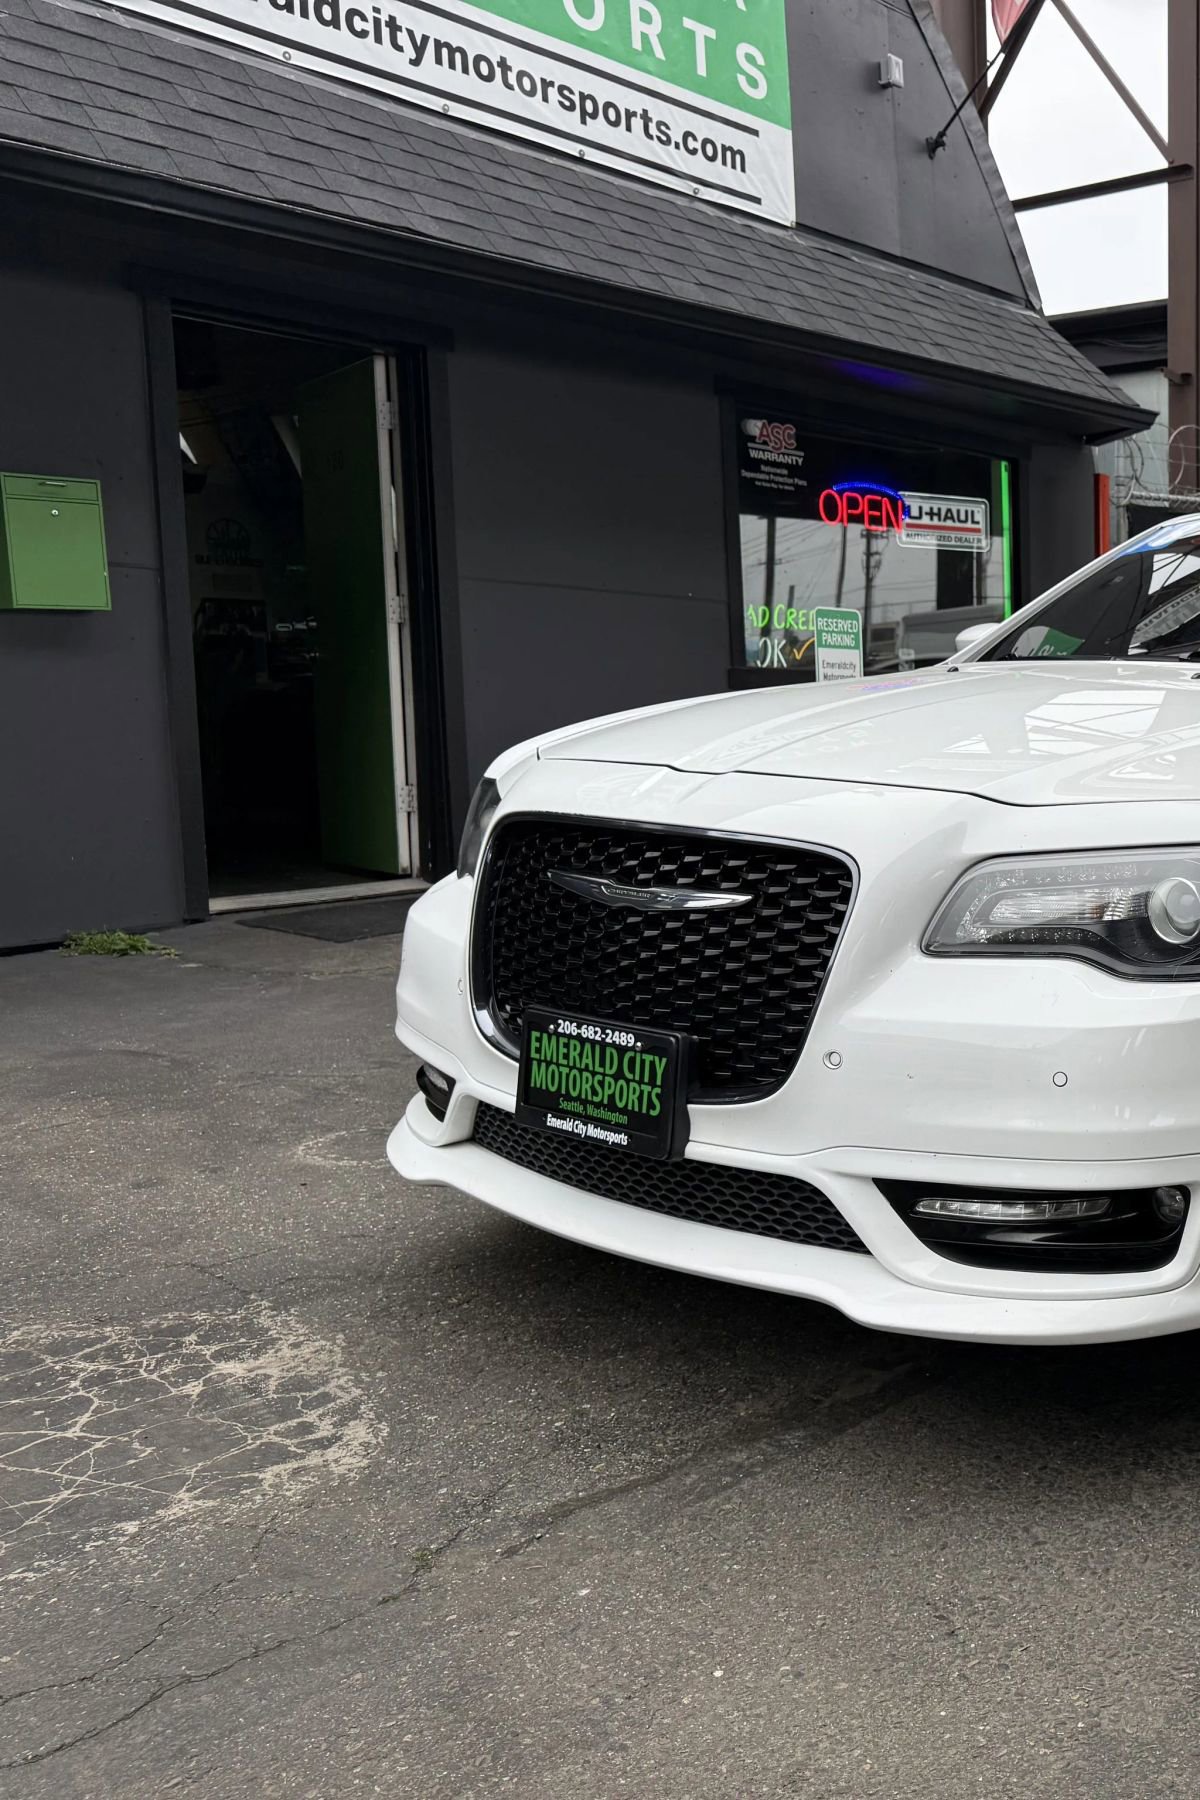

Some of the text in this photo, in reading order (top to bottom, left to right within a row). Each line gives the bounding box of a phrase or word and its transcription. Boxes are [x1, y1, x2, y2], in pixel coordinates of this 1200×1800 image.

[756, 420, 797, 453] ASC
[748, 449, 804, 466] WARRANTY
[819, 489, 903, 535] OPEN
[903, 503, 981, 525] U-HAUL
[954, 535, 983, 545] DEALER
[817, 618, 859, 633] RESERVED
[822, 632, 856, 647] PARKING
[557, 1019, 636, 1048] 206-682-2489
[530, 1030, 668, 1086] EMERALD CITY
[530, 1061, 662, 1117] MOTORSPORTS
[559, 1097, 628, 1125] Seattle, Washington
[547, 1113, 628, 1146] Emerald City Motorsports
